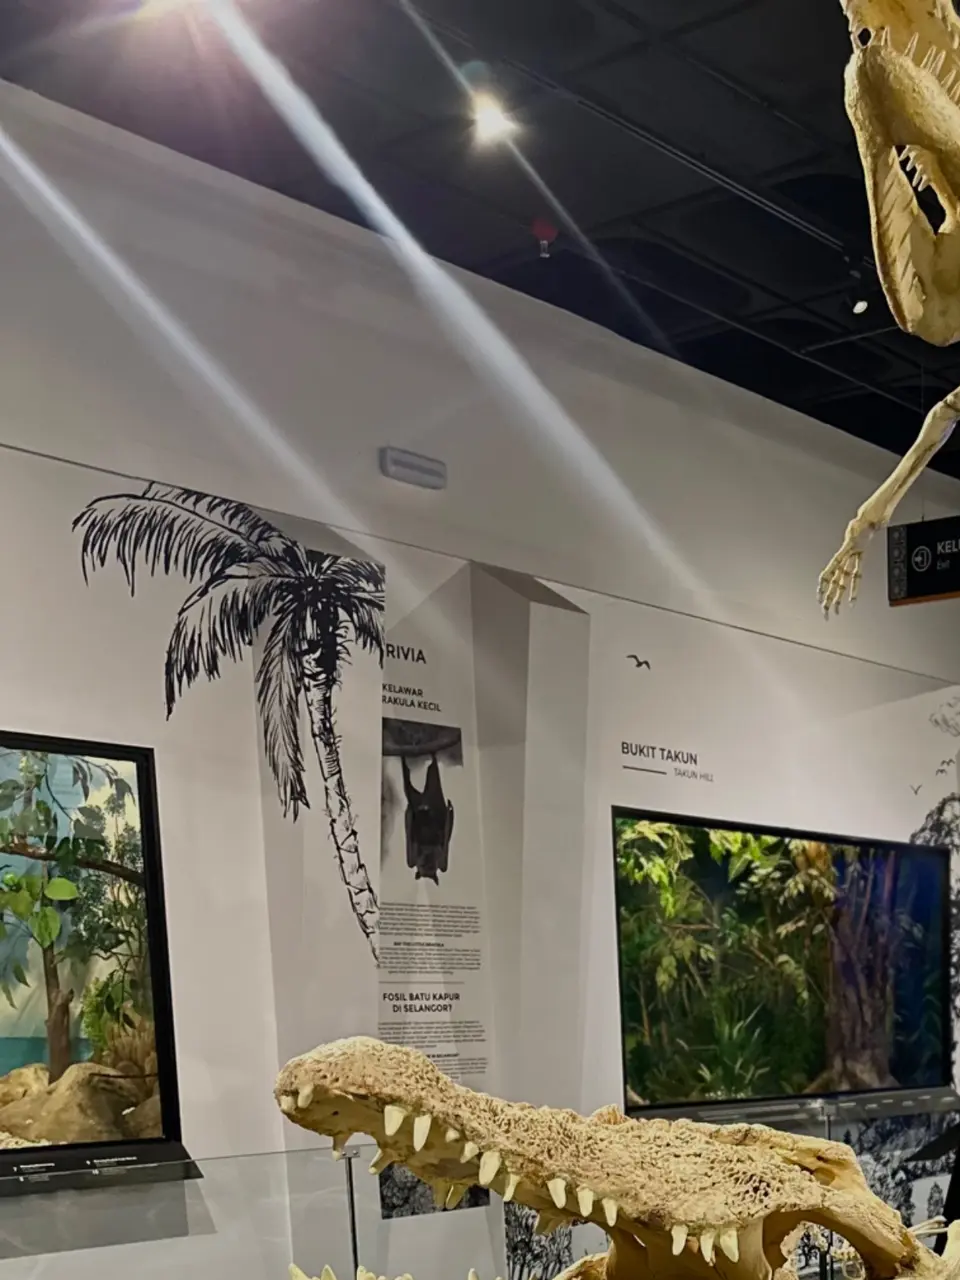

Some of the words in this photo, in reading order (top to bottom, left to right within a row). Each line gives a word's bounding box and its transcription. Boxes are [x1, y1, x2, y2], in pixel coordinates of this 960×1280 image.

[385, 642, 427, 665] RIVIA
[382, 683, 424, 698] KELAWAR
[382, 695, 416, 709] RAKULA
[417, 700, 442, 712] KECIL
[621, 741, 656, 759] BUKIT
[659, 747, 698, 766] TAKUN
[673, 767, 698, 780] TAKUN
[383, 993, 407, 1001] FOSIL
[408, 993, 430, 1001] BATU
[432, 993, 460, 1001] KAPUR
[392, 1004, 401, 1013] DI
